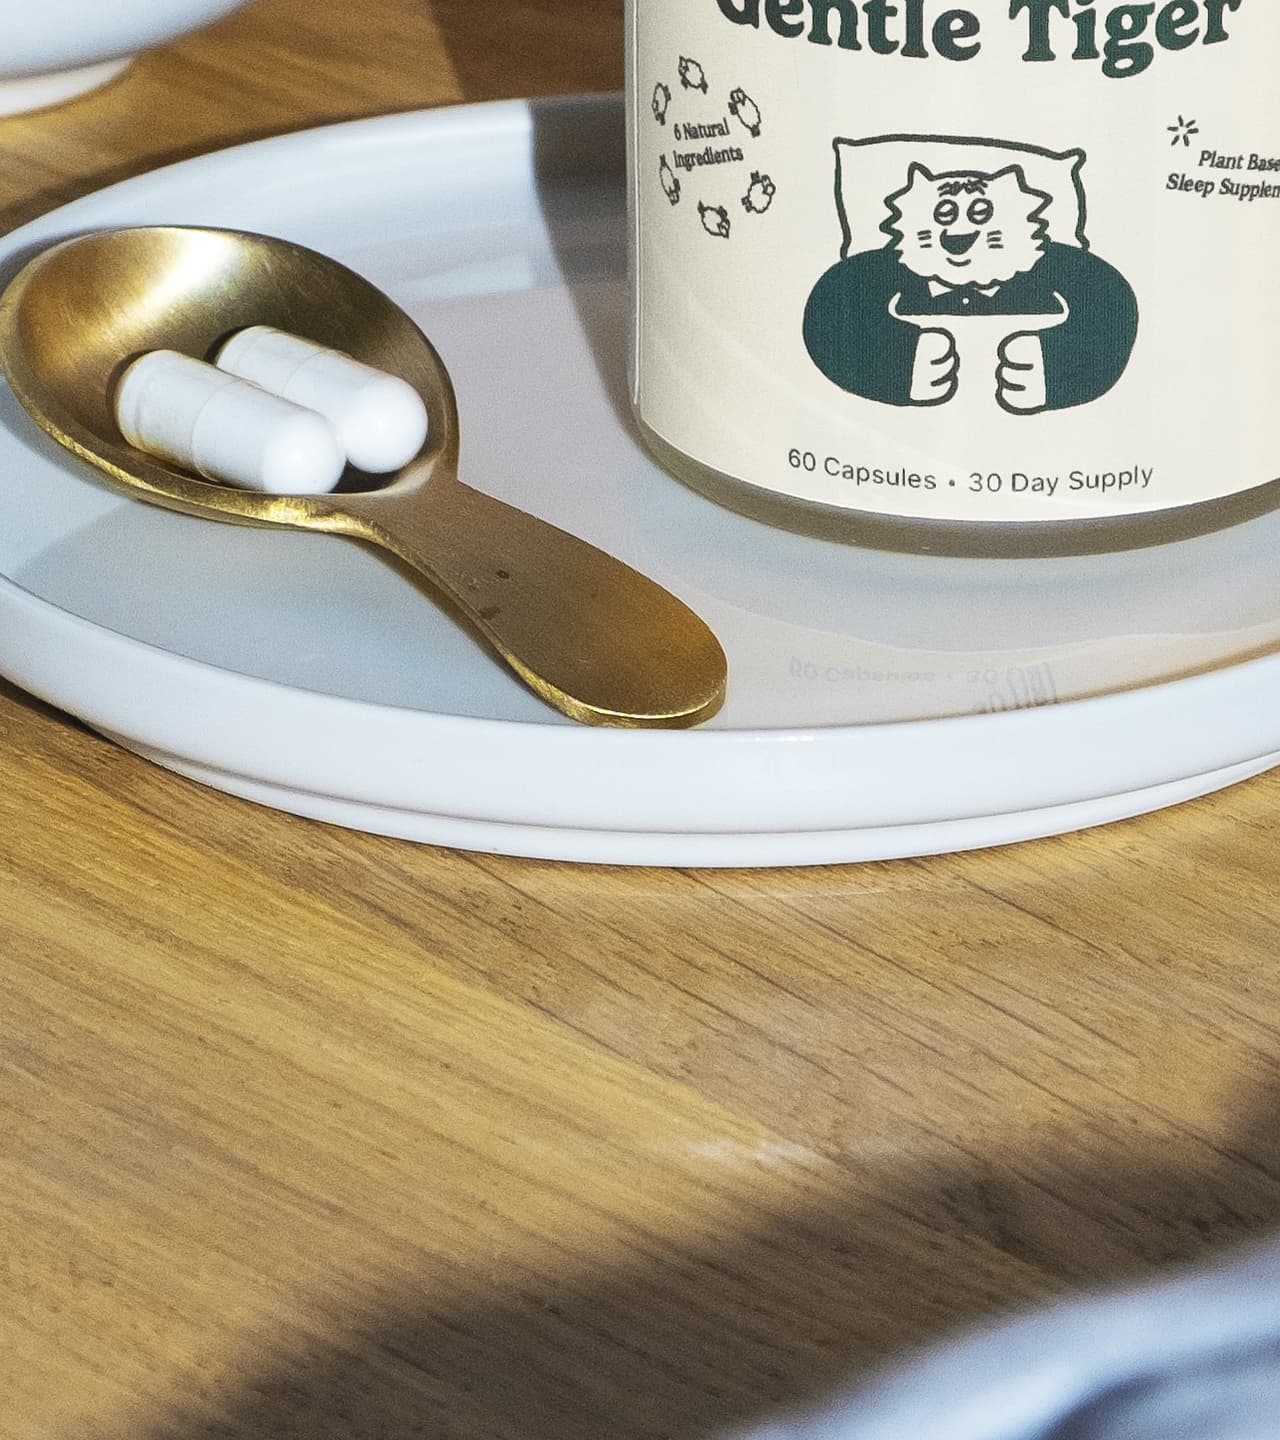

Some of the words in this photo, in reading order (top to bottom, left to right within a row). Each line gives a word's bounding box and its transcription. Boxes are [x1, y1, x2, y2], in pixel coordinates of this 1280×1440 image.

[674, 123, 681, 141] 6
[683, 117, 730, 140] Natural
[1199, 150, 1244, 169] Plant
[1166, 173, 1214, 198] Sleep
[789, 449, 816, 471] 60
[825, 457, 936, 489] Capsules
[970, 473, 1001, 492] 30
[1012, 473, 1058, 496] Day
[1069, 466, 1152, 492] Supply
